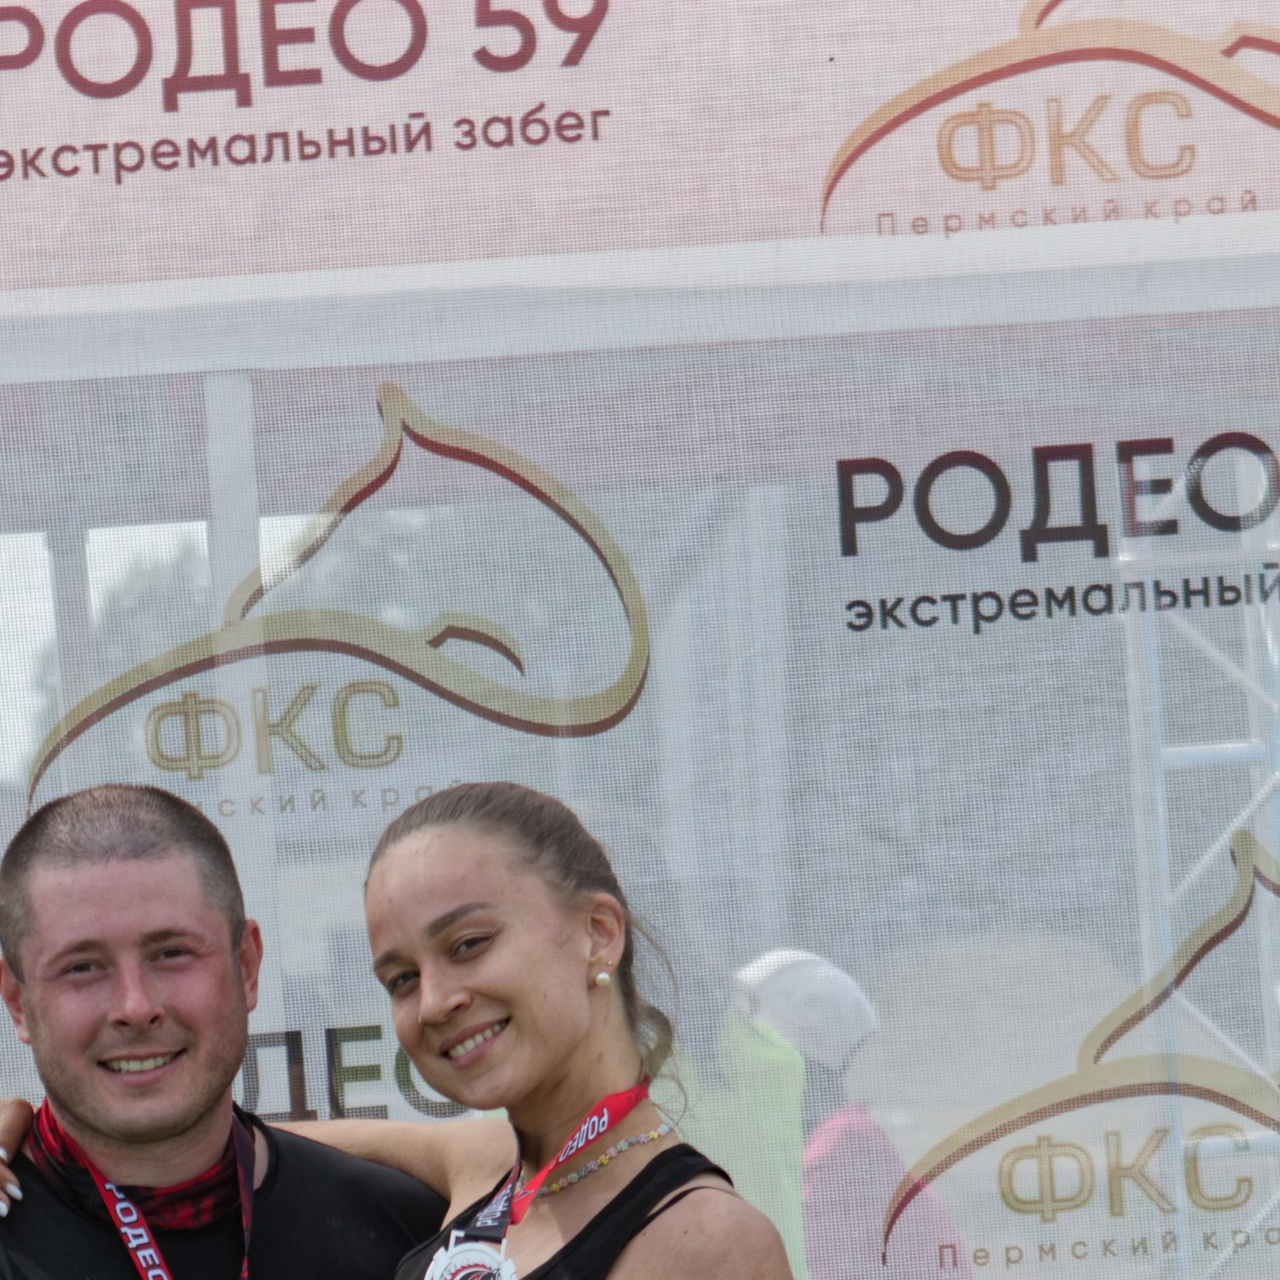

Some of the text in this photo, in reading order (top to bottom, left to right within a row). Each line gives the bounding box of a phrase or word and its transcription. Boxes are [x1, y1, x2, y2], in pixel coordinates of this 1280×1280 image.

[472, 0, 611, 73] 59
[453, 103, 612, 152] забег
[936, 90, 1198, 191] ФКС
[876, 190, 1260, 240] Пермский край
[836, 431, 1280, 563] РОДЕО
[144, 679, 404, 781] ФКС
[997, 1122, 1254, 1223] ФКС
[938, 1232, 1179, 1270] Пермский
